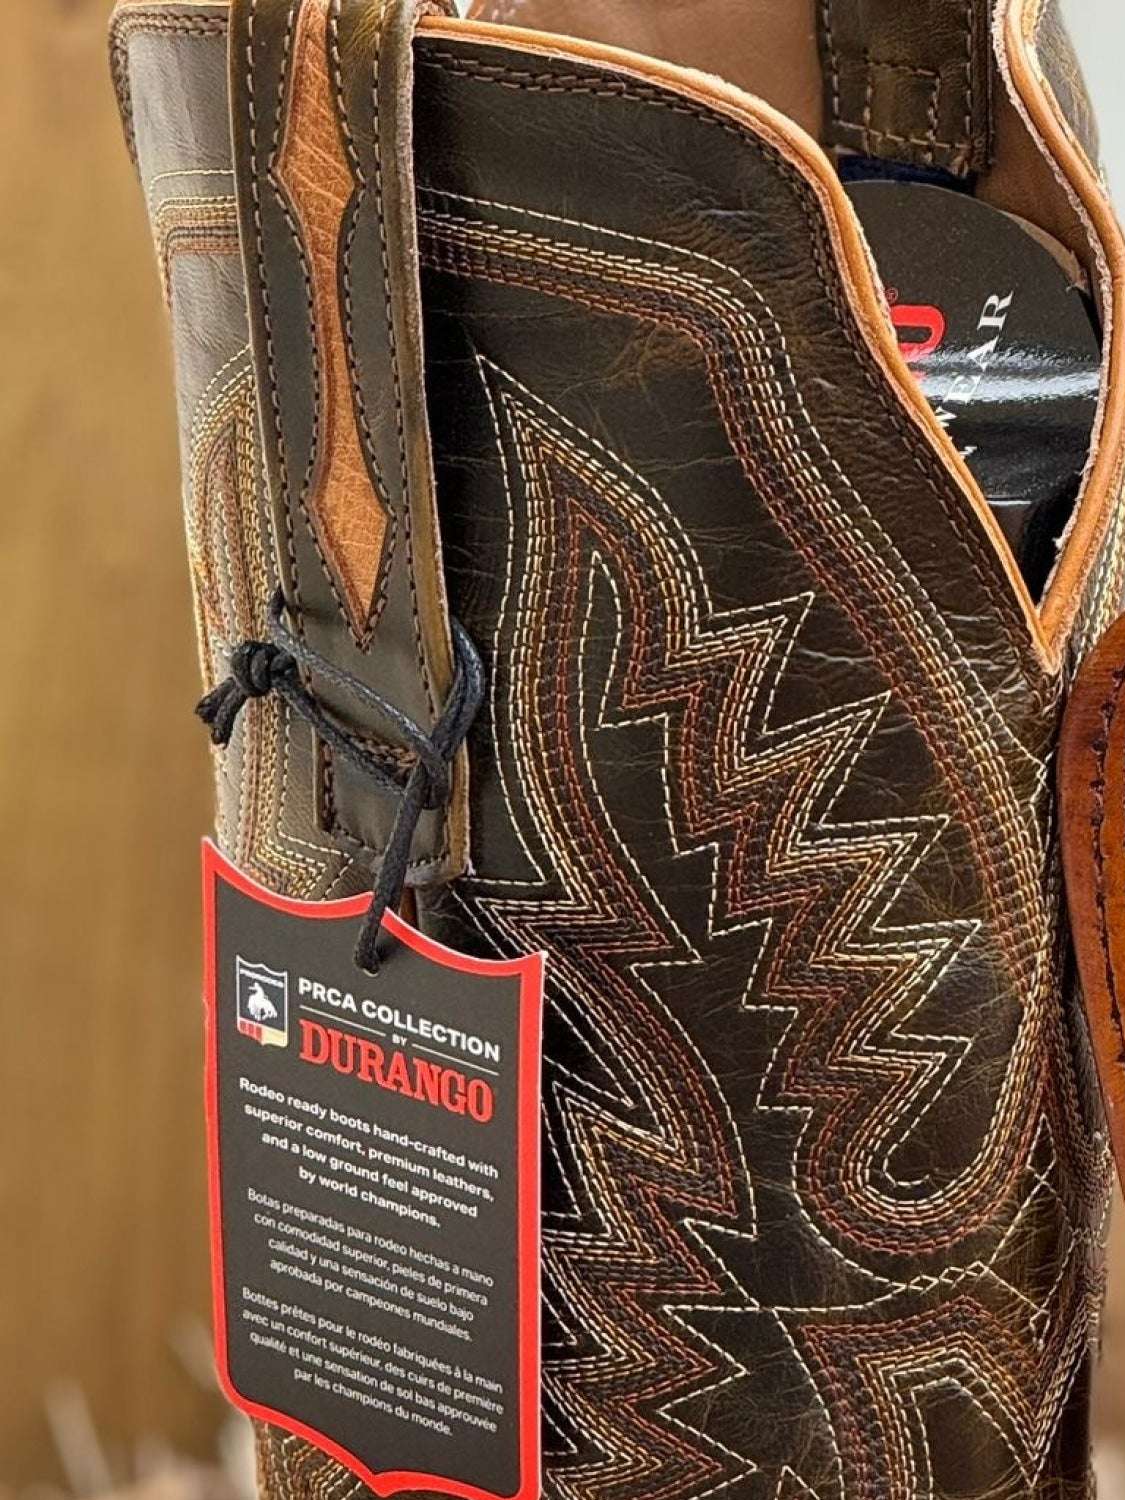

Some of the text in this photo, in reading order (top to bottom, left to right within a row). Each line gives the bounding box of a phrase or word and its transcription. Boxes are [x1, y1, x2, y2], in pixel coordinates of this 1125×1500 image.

[299, 977, 357, 1013] PRCA
[362, 1000, 499, 1062] COLLECTION
[392, 1034, 408, 1046] BY
[299, 1019, 494, 1123] DURANGO
[239, 1076, 497, 1179] Rodeo ready boots hand-crafted with
[244, 1105, 494, 1202] superior comfort, premium leathers,
[261, 1132, 477, 1218] and a low ground feel approved
[299, 1165, 440, 1227] by world champions.
[249, 1187, 493, 1287] Botas preparadas para rodeo hechas a mano
[254, 1213, 274, 1228] con
[278, 1221, 340, 1251] comodidad
[392, 1263, 425, 1283] pieles
[427, 1275, 441, 1289] de
[444, 1282, 487, 1306] primera
[268, 1239, 473, 1322] calidad y una sensación de suelo bajo
[270, 1260, 322, 1286] aprobada
[324, 1280, 343, 1294] por
[345, 1286, 410, 1318] campeones
[243, 1286, 278, 1311] Bottes
[318, 1317, 343, 1334] pour
[345, 1325, 355, 1339] le
[393, 1342, 451, 1374] fabriquées
[463, 1367, 473, 1382] la
[475, 1376, 502, 1393] main
[243, 1309, 268, 1327] avec
[271, 1319, 284, 1332] un
[287, 1325, 326, 1347] confort
[384, 1360, 404, 1377] des
[407, 1370, 434, 1389] cuirs
[437, 1378, 450, 1395] de
[288, 1345, 299, 1358] et
[302, 1350, 321, 1366] une
[324, 1358, 377, 1388] sensation
[380, 1379, 393, 1394] de
[396, 1386, 412, 1400] sol
[415, 1391, 434, 1409] bas
[438, 1403, 496, 1432] approuvée
[294, 1368, 311, 1382] par
[314, 1373, 329, 1389] les
[332, 1380, 391, 1413] champions
[394, 1402, 408, 1420] du
